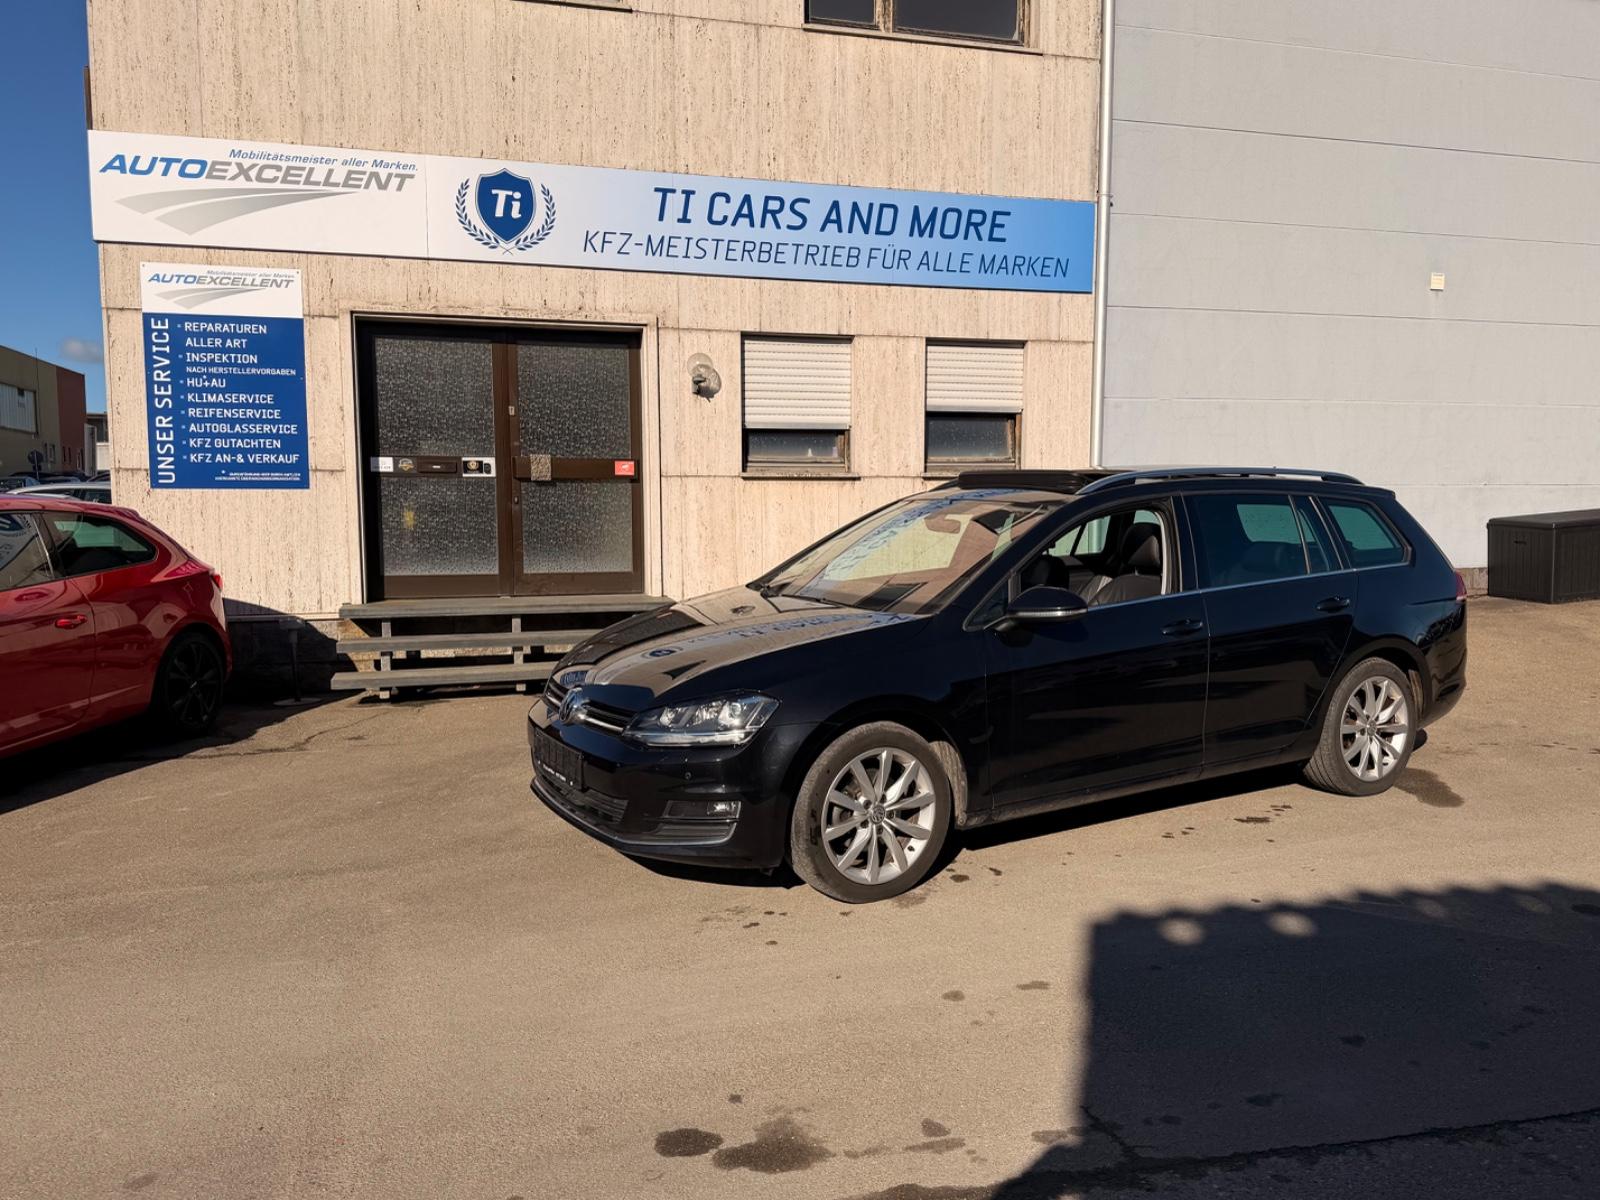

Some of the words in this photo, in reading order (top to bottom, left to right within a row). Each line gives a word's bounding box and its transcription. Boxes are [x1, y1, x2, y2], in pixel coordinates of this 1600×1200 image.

[228, 149, 338, 165] Mobilitätsmeister
[341, 157, 366, 167] aller
[371, 158, 418, 171] Marken.
[491, 188, 522, 219] Ti
[654, 187, 696, 224] TI
[706, 191, 811, 231] CARS
[819, 200, 899, 236] AND
[909, 204, 1011, 242] MORE
[583, 230, 861, 268] KFZ-MEISTERBETRIEB
[866, 244, 912, 270] FÜR
[916, 250, 974, 273] ALLE
[978, 254, 1070, 278] MARKEN
[184, 322, 267, 334] REPARATUREN
[185, 337, 222, 348] ALLER
[225, 338, 248, 349] ART
[151, 318, 173, 409] SERVICE
[186, 352, 258, 364] INSPEKTION
[186, 366, 207, 374] NACH
[208, 367, 296, 376] HERSTELLERVORGABEN
[186, 378, 226, 388] HU+AU
[187, 393, 275, 404] KLIMASERVICE
[188, 408, 281, 419] REIFENSERVICE
[189, 423, 298, 435] AUTOGLASSERVICE
[155, 415, 175, 483] UNSER
[189, 438, 211, 448] KFZ
[214, 438, 281, 449] GUTACHTEN
[190, 453, 212, 463] KFZ
[247, 454, 300, 464] VERKAUF
